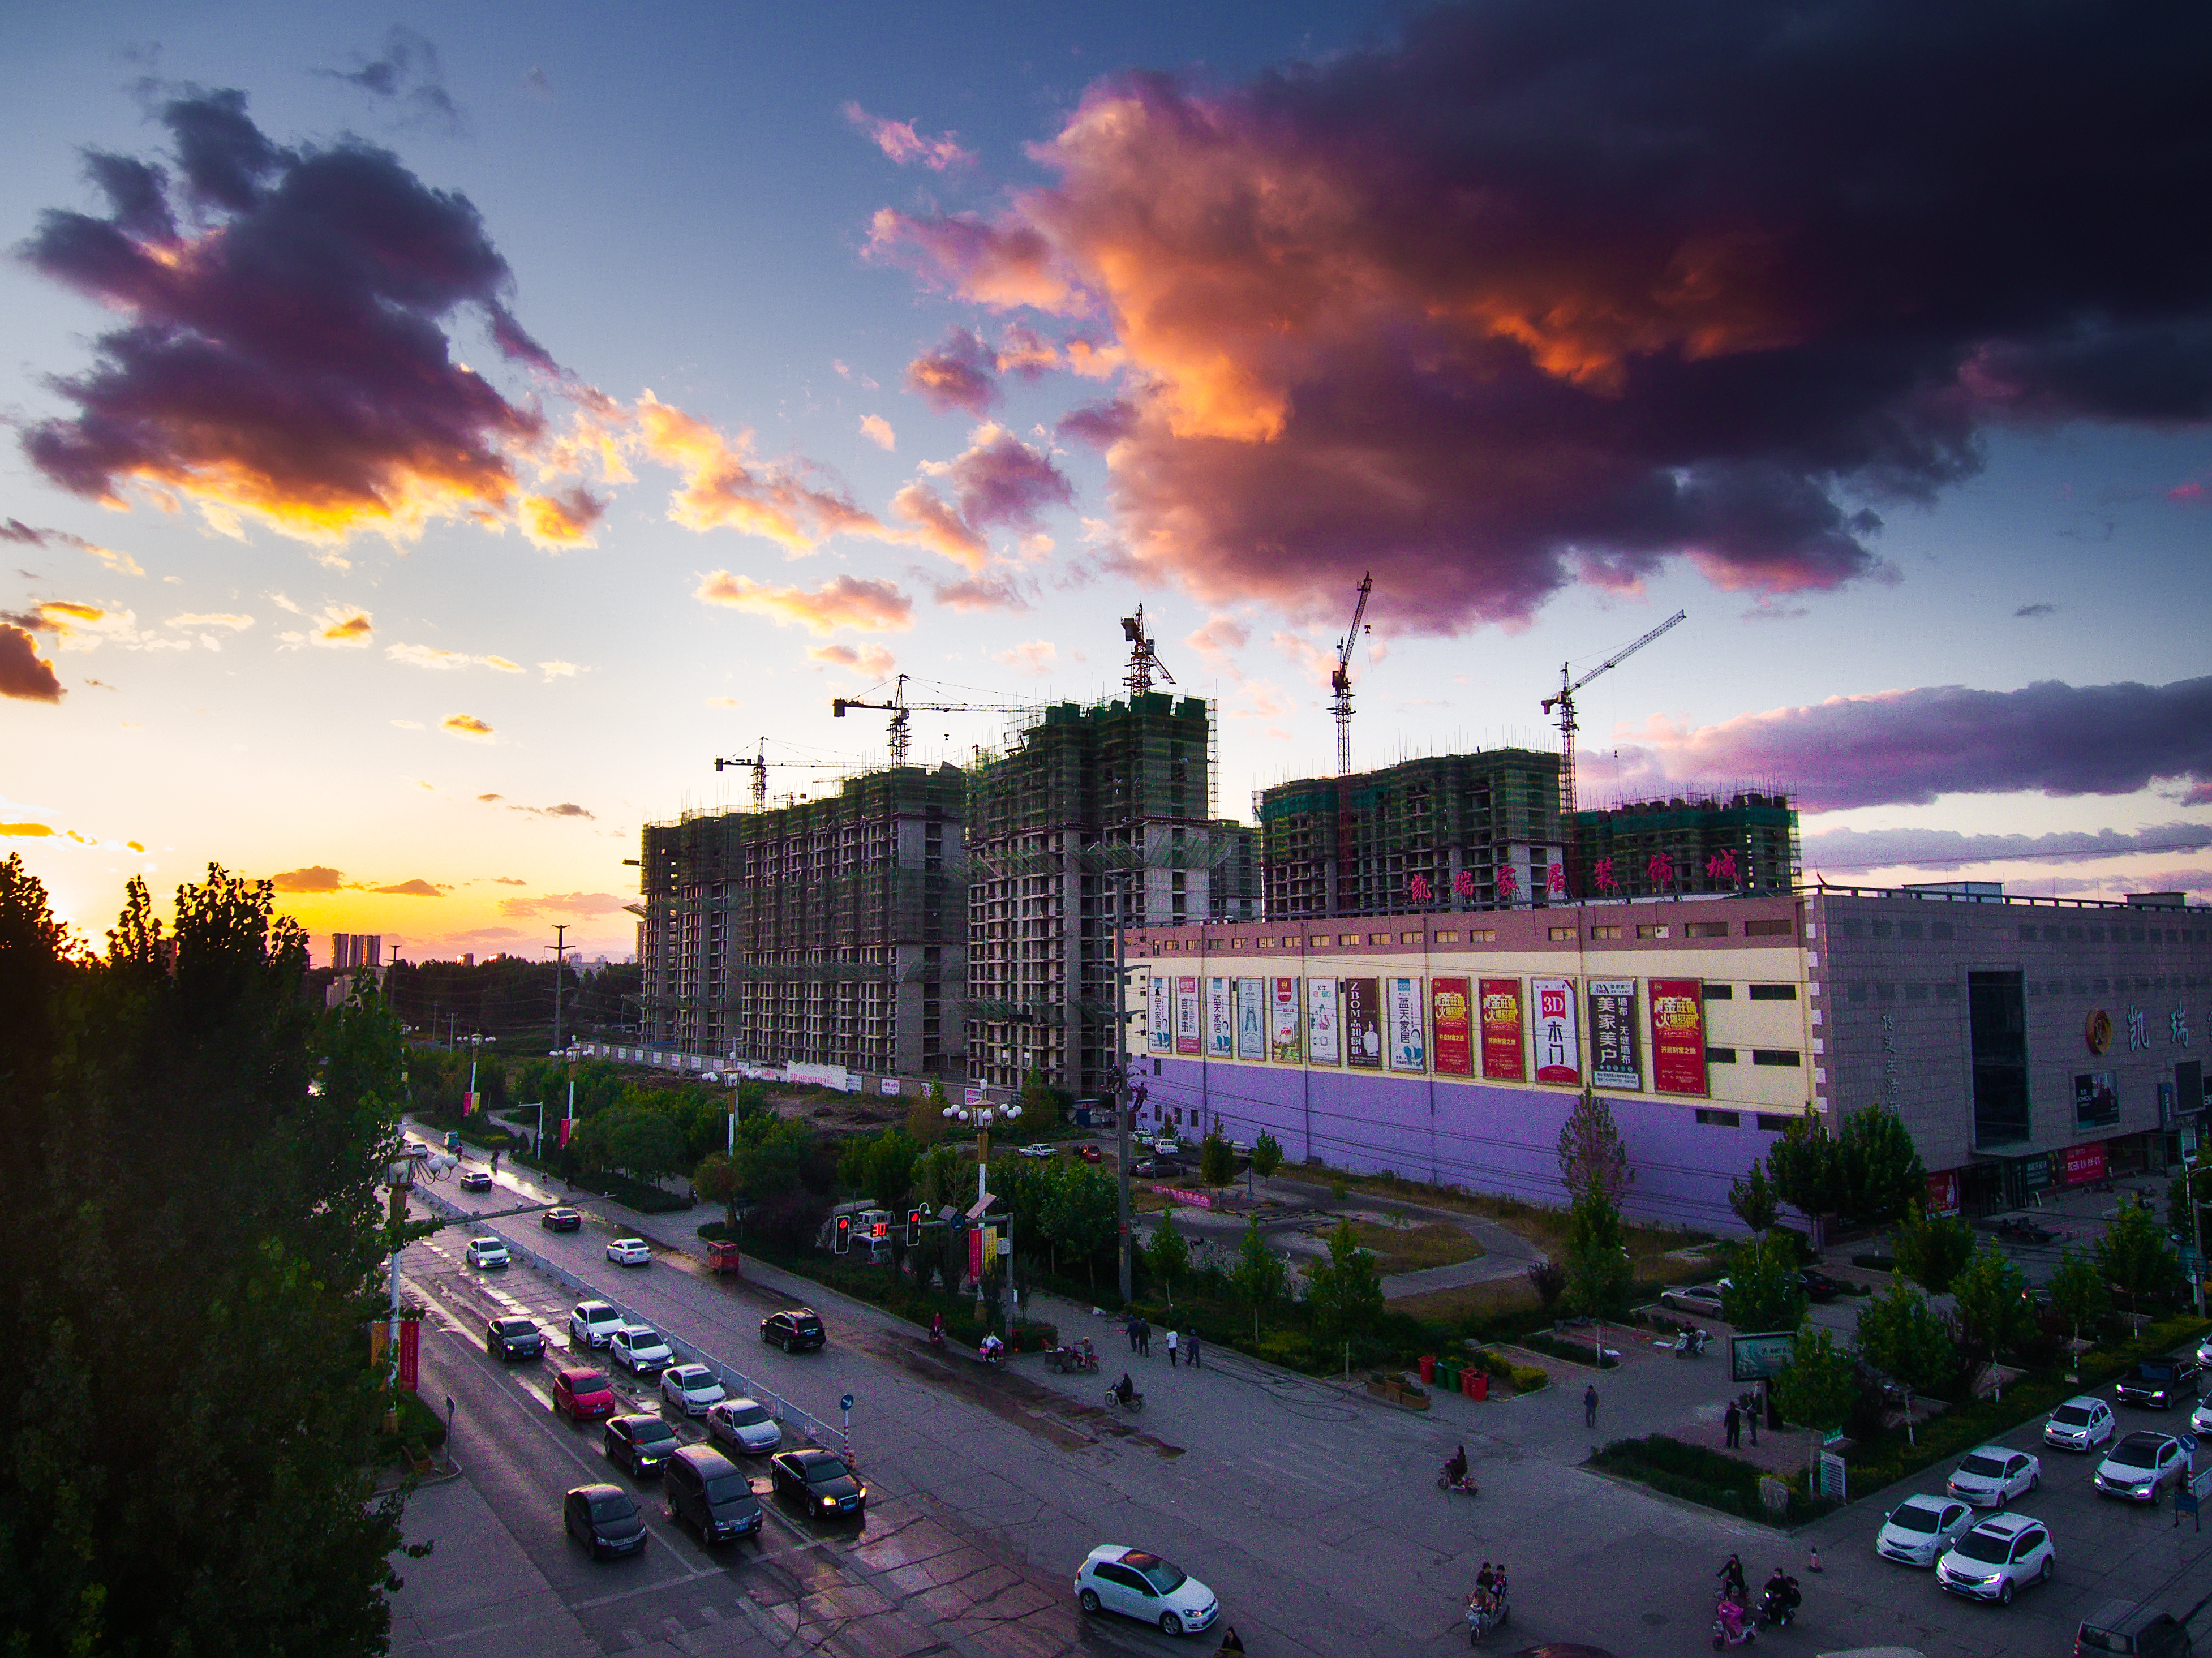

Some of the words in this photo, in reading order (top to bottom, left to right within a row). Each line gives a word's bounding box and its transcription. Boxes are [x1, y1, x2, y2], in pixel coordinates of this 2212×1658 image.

[1350, 982, 1360, 1017] ZBOM
[1398, 997, 1410, 1043] 蓝天家居
[1544, 996, 1564, 1012] 3D
[1548, 1021, 1564, 1064] 木门
[1597, 997, 1617, 1063] 美家美户
[2128, 1000, 2212, 1051] 凯瑞
[872, 1223, 887, 1237] 30
